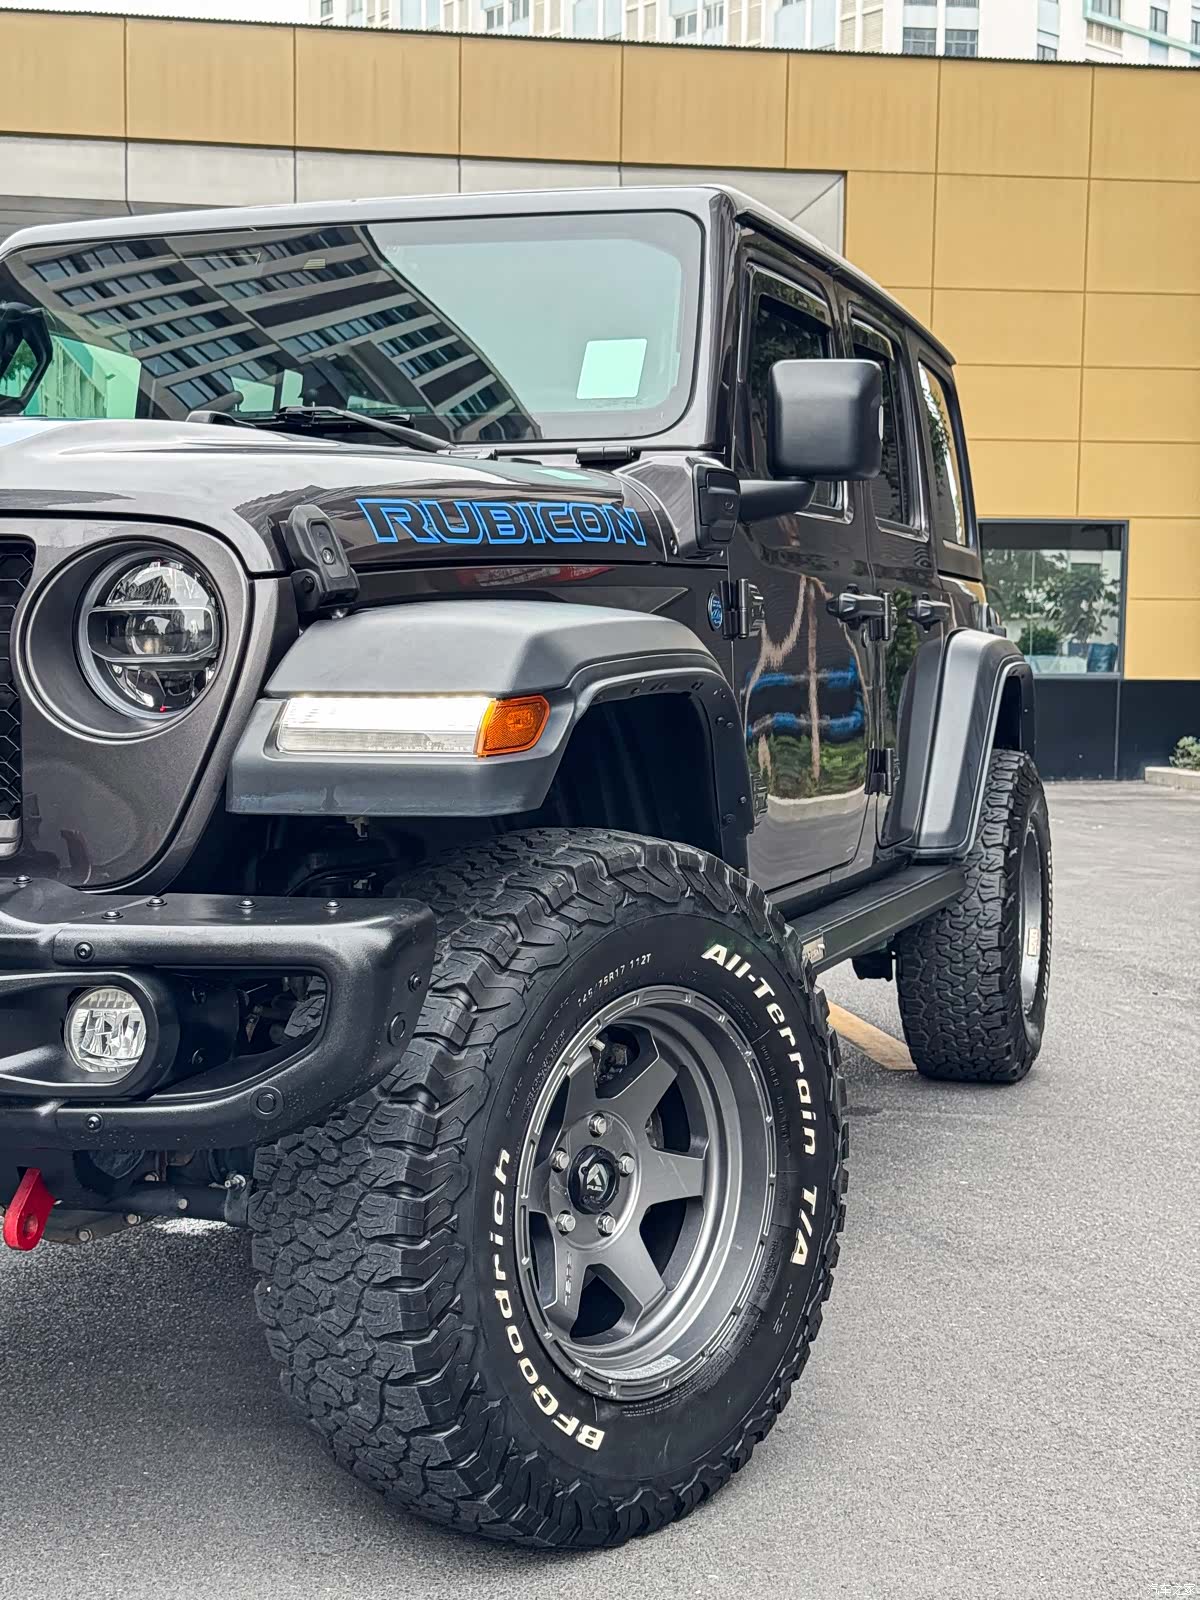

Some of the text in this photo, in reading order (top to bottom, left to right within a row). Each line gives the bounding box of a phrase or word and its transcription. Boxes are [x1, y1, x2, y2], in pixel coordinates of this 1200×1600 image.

[355, 498, 648, 547] RUBICON
[700, 943, 817, 1156] All-Terrain
[789, 1185, 818, 1266] T/A
[489, 1148, 606, 1451] BFGoodrich
